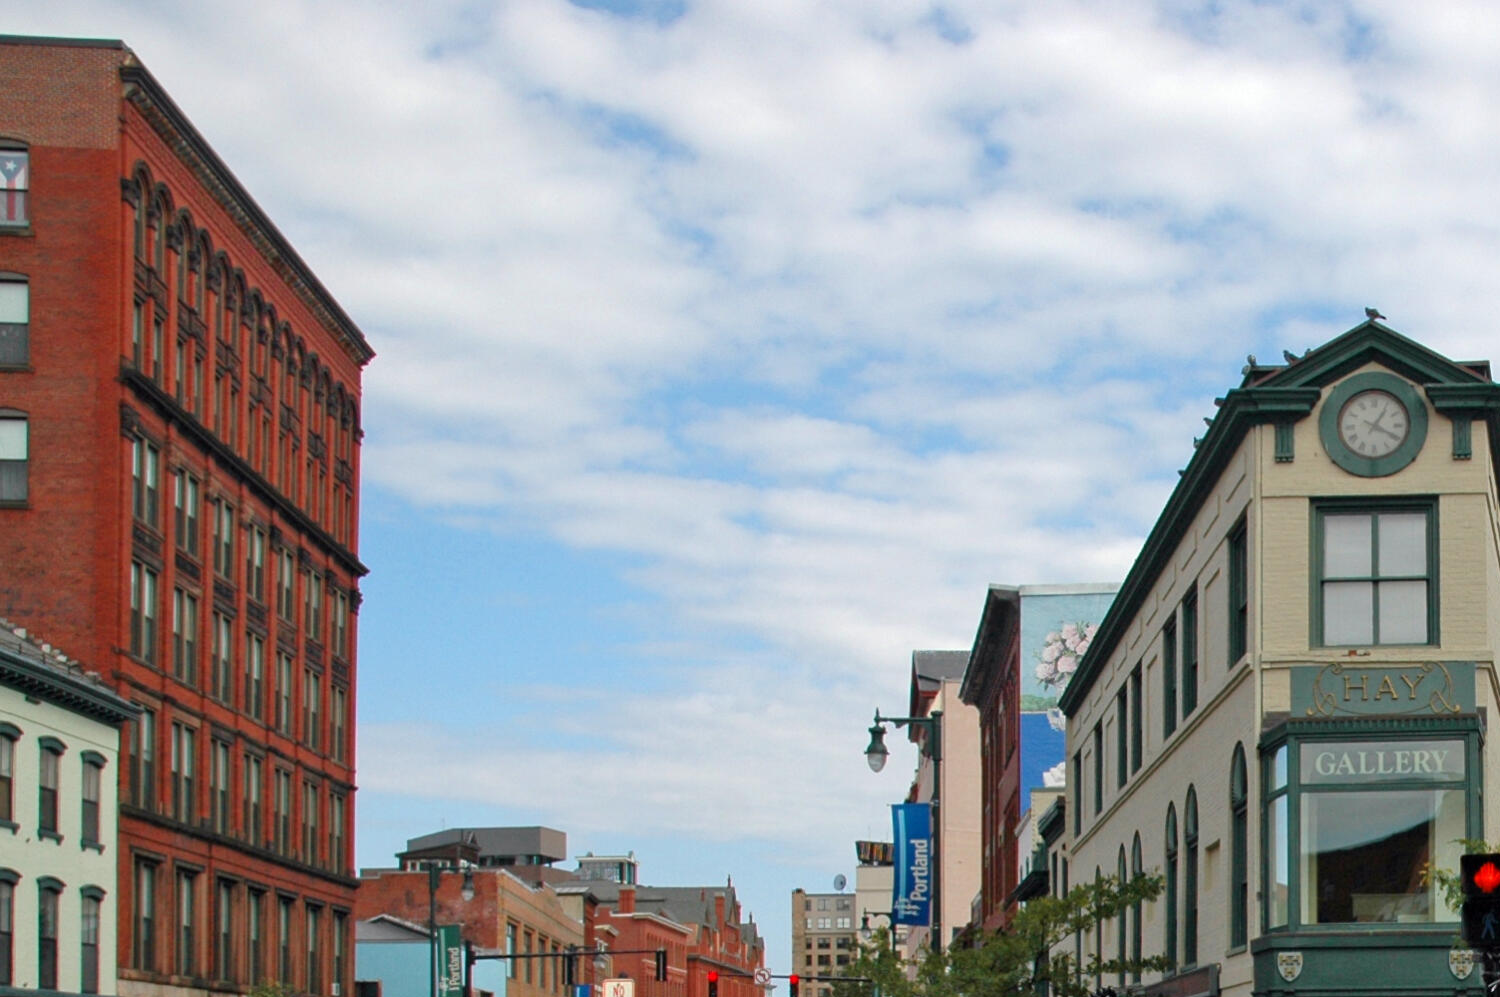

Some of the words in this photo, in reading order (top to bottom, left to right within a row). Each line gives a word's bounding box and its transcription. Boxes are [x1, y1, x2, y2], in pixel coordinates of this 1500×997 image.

[1343, 674, 1424, 701] HAY
[1315, 749, 1449, 776] GALLERY
[910, 839, 928, 901] Portland
[613, 985, 625, 997] NO
